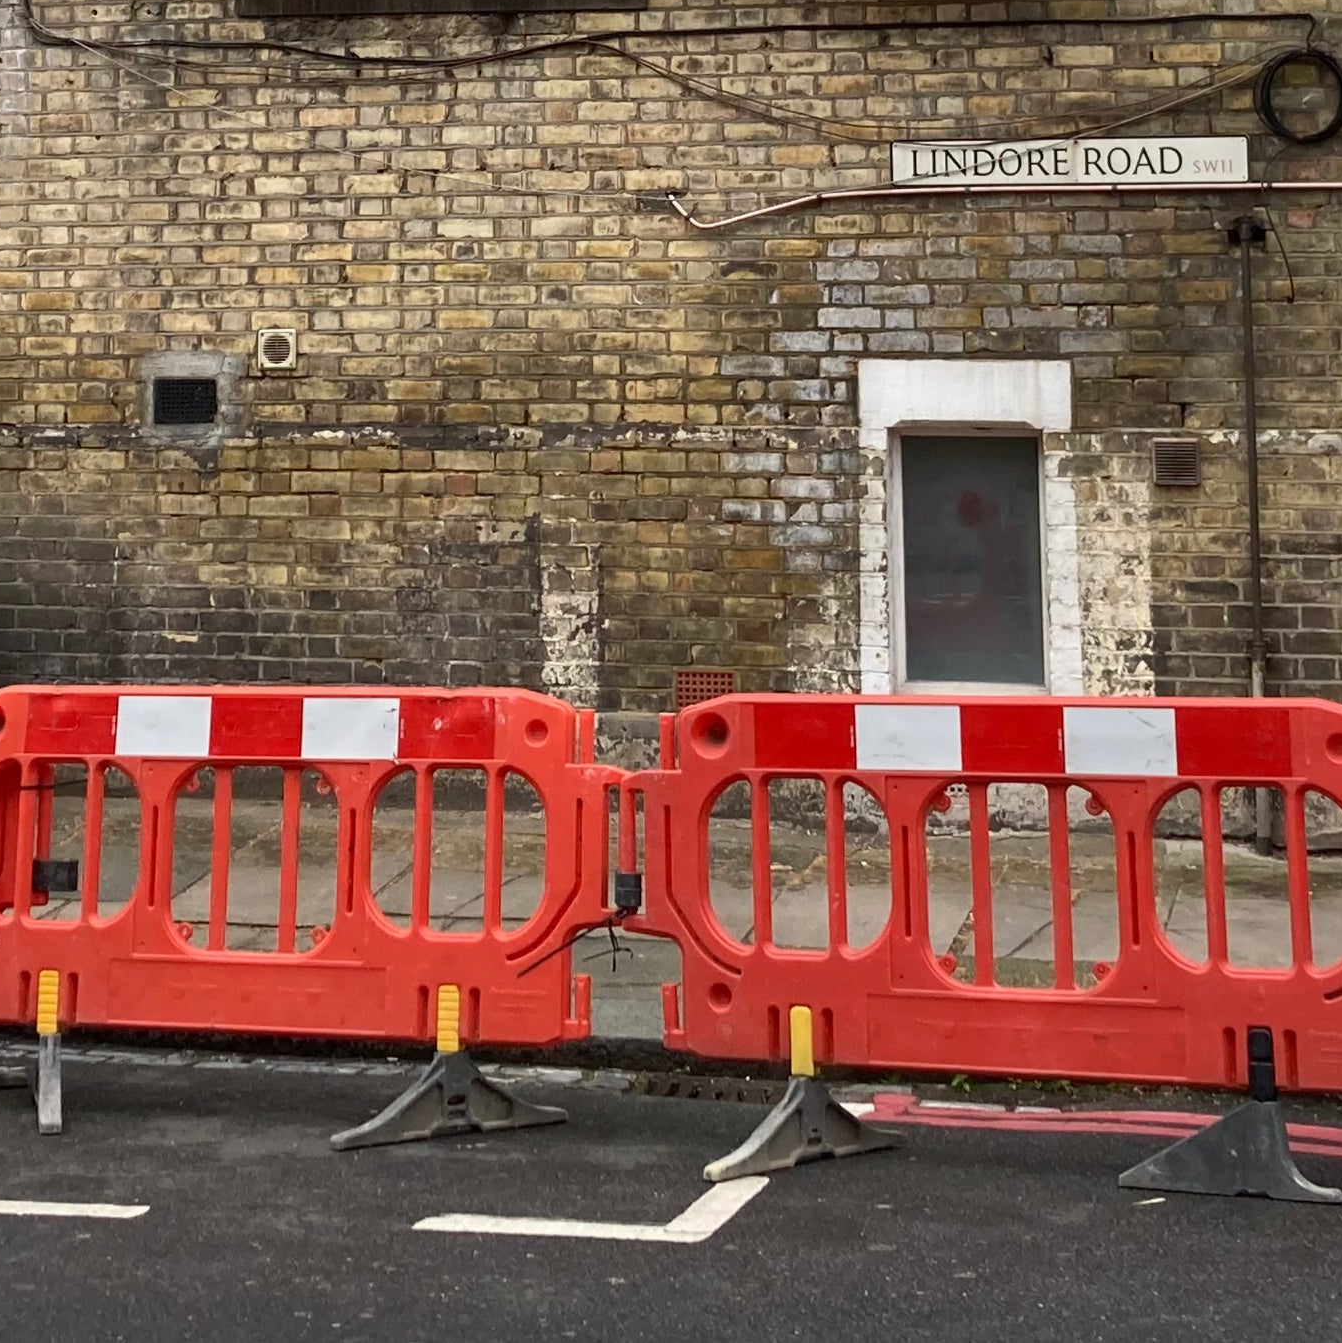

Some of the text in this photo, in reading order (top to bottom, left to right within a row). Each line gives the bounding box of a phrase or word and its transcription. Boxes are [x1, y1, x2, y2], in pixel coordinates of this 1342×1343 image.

[911, 146, 1234, 178] LINDORE ROAD SW11
